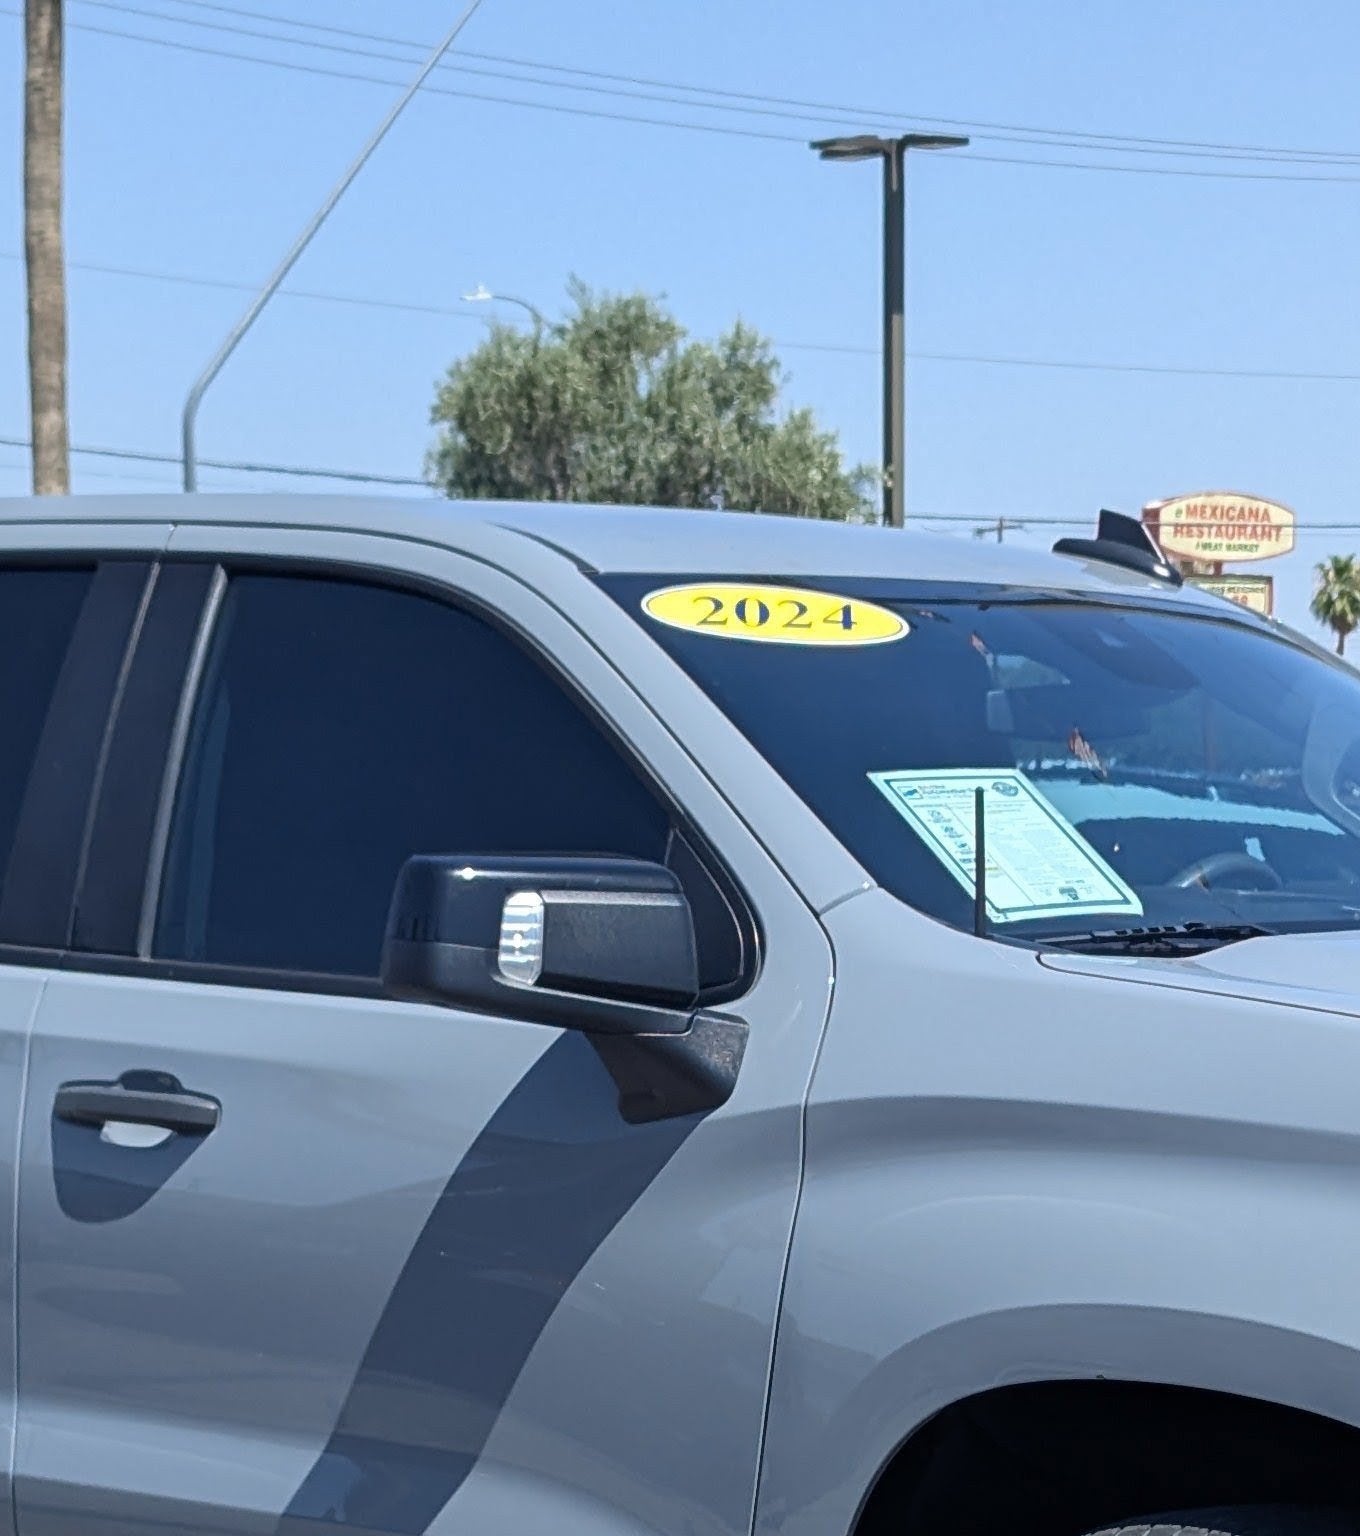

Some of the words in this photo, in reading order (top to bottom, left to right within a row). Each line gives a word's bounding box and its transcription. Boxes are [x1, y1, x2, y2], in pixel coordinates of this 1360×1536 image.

[1185, 503, 1271, 523] MEXICANA
[1173, 520, 1283, 542] RESTAURANT
[692, 595, 858, 631] 2024
